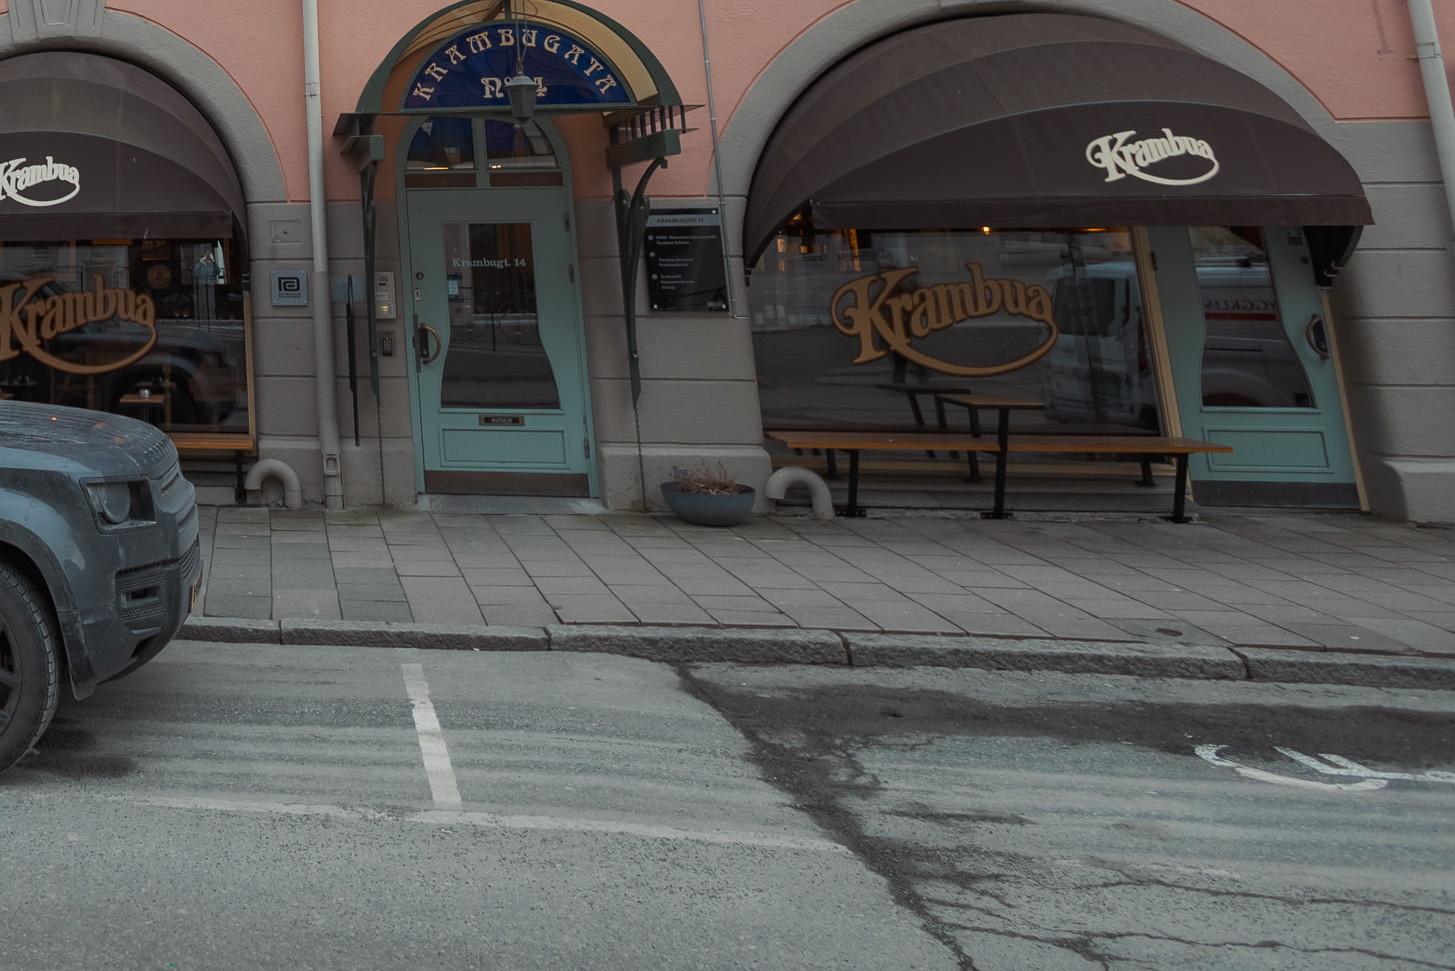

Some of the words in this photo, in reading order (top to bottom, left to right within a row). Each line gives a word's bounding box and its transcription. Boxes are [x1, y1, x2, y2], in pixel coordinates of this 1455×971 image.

[412, 28, 617, 101] KRAMBUGATA
[1085, 128, 1220, 186] Krambua
[452, 257, 511, 269] Krambugt.
[514, 258, 526, 267] 14
[829, 262, 1060, 376] Krambua
